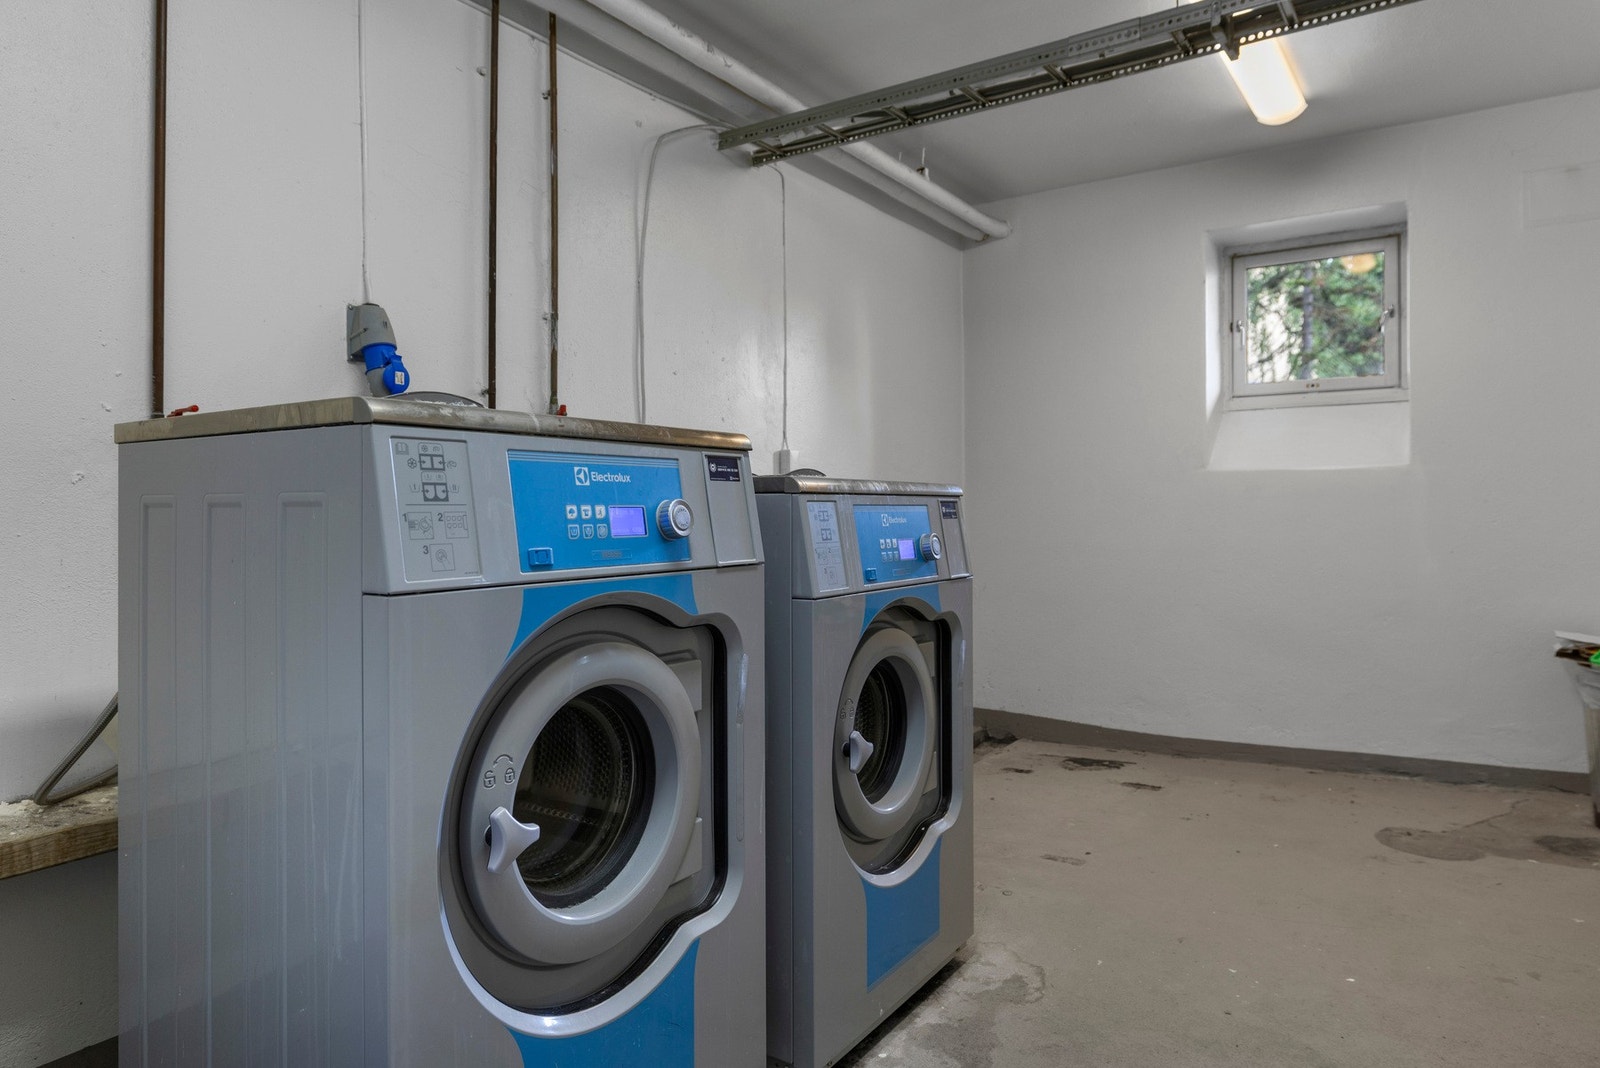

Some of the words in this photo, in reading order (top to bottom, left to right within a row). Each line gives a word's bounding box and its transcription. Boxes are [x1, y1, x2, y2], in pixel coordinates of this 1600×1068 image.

[591, 471, 631, 483] Electrolux
[402, 512, 408, 522] 1
[437, 512, 443, 522] 2
[422, 545, 429, 554] 3
